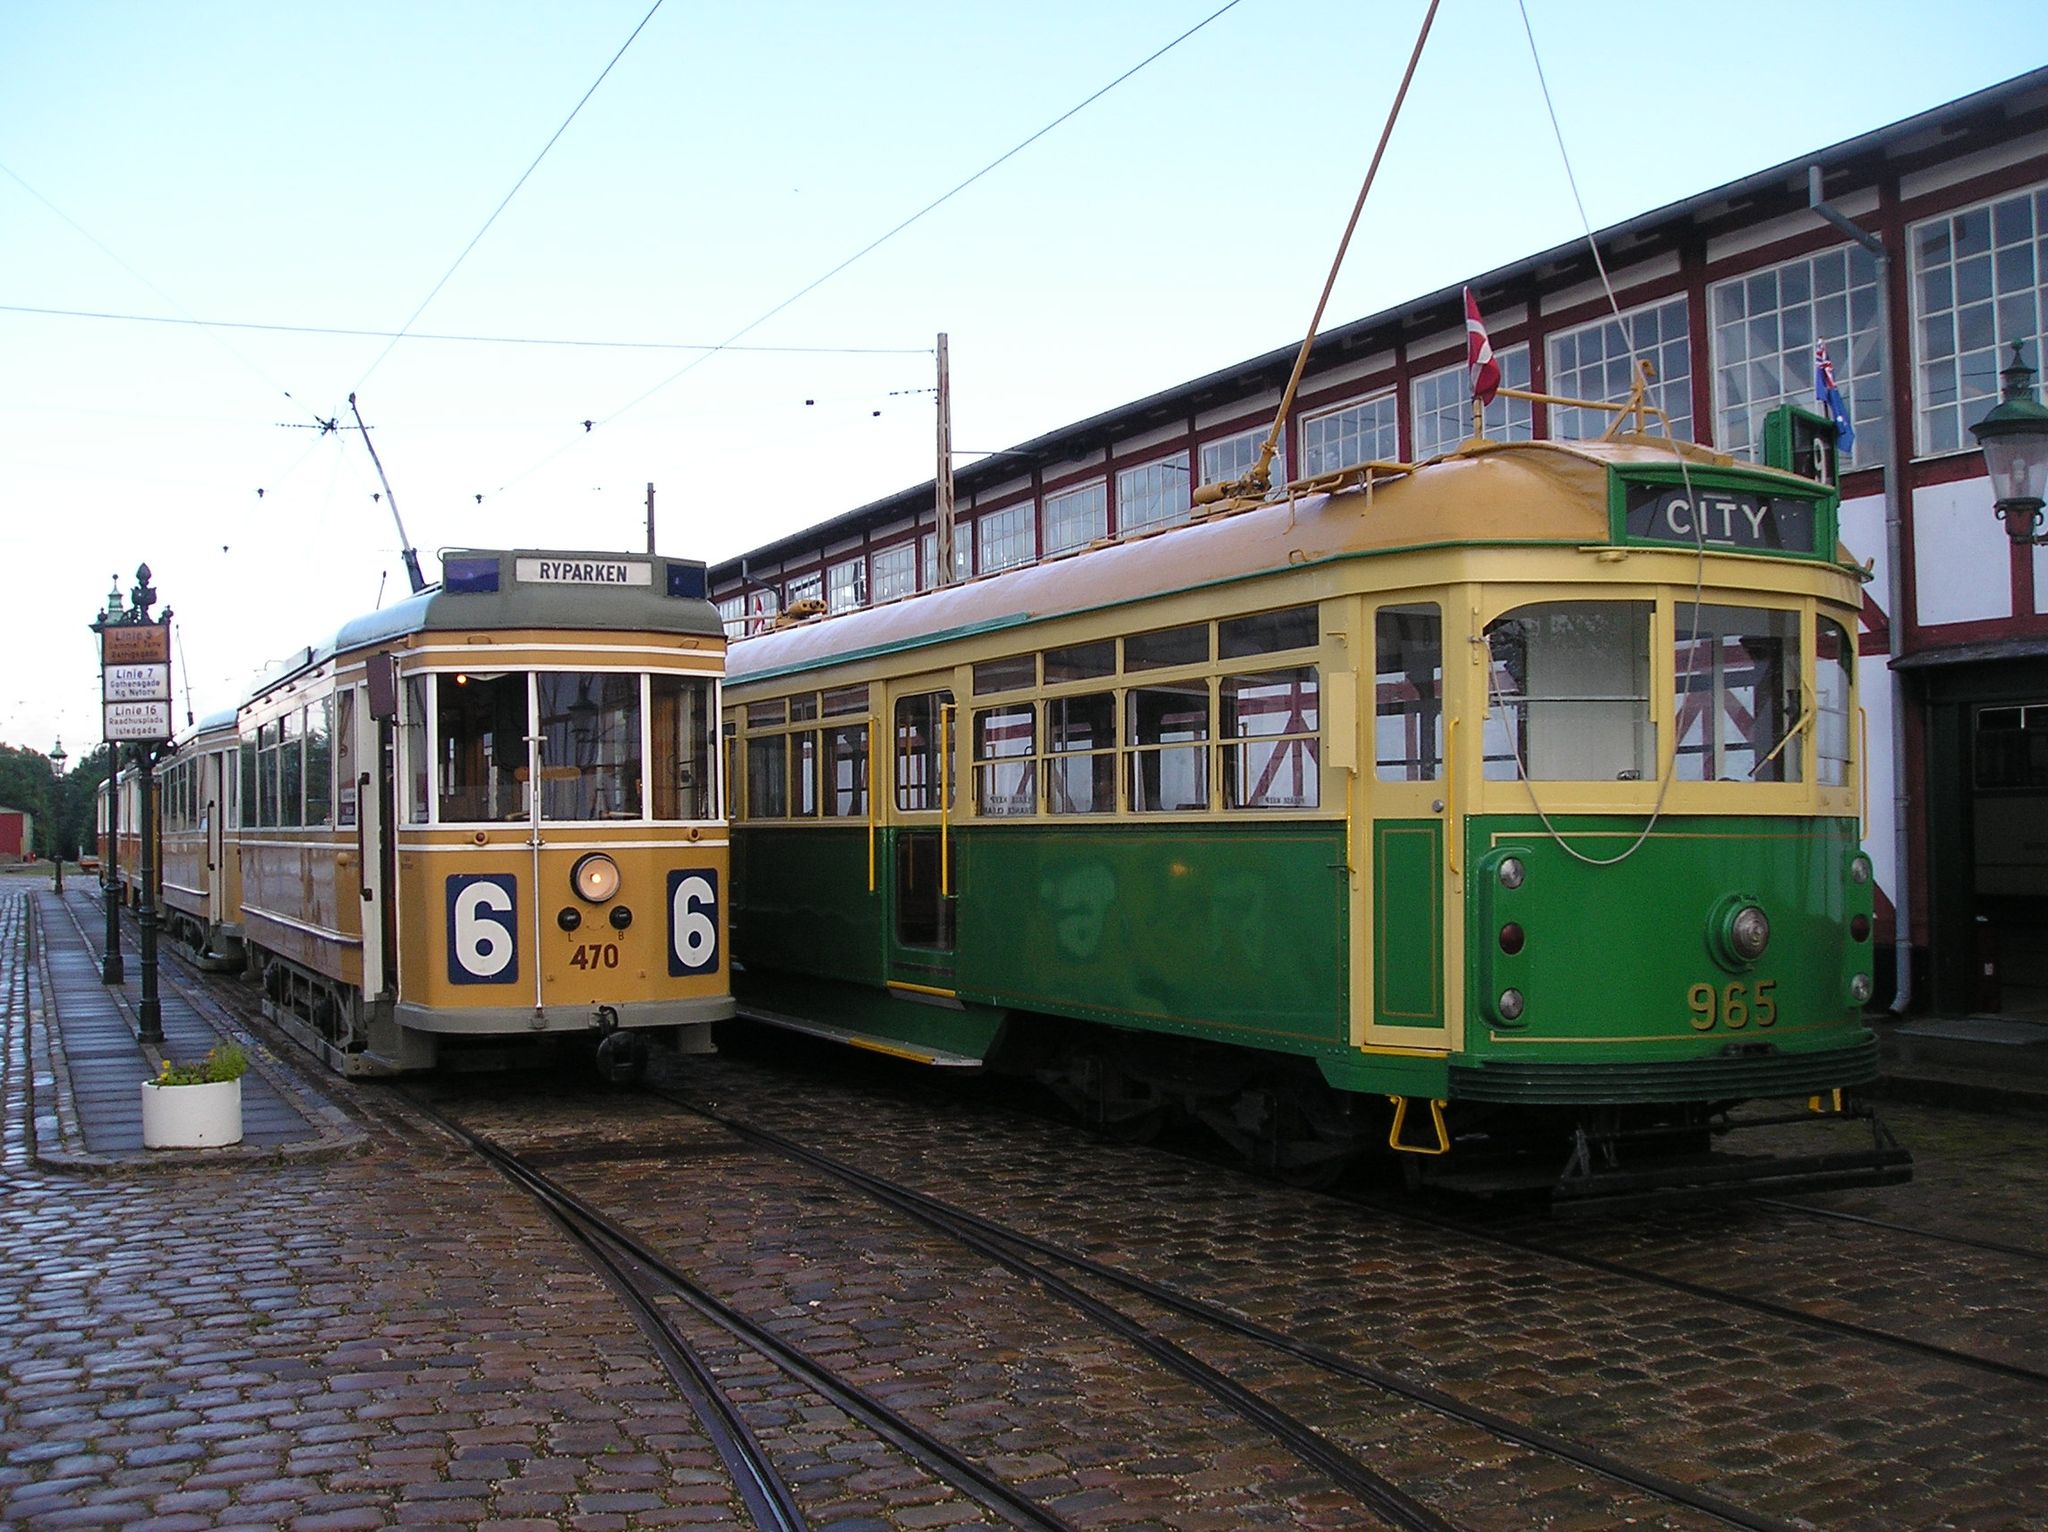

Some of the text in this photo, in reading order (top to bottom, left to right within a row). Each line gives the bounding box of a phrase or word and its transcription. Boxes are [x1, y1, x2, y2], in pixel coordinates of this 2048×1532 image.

[1666, 498, 1768, 539] CITY
[540, 562, 627, 582] RYPARKEN
[116, 668, 154, 679] Linie 7
[116, 705, 156, 716] Linie 16
[455, 881, 513, 977] 6
[673, 876, 716, 968] 6
[569, 943, 619, 970] 470
[1687, 979, 1777, 1031] 965
